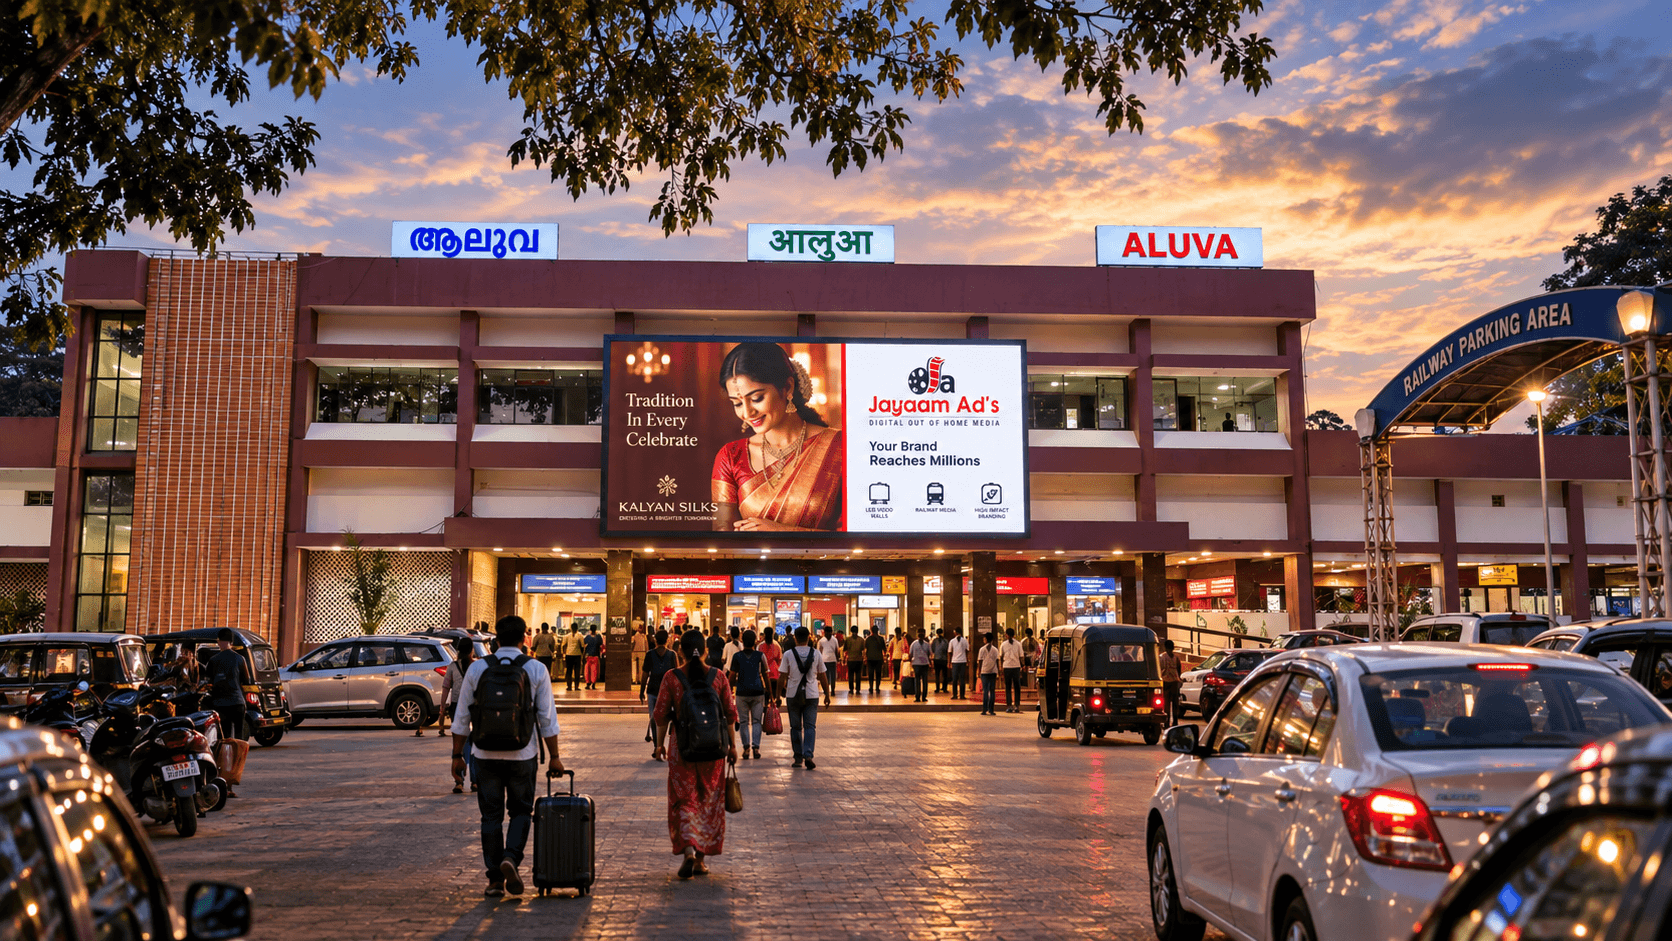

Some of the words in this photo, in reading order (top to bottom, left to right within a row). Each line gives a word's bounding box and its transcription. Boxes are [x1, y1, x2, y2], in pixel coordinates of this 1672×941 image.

[410, 227, 539, 259] ആലുവ
[769, 230, 873, 262] आलुआ
[1122, 232, 1239, 259] ALUVA
[1403, 343, 1454, 396] RAILWAY
[1459, 312, 1521, 357] PARKING
[1526, 302, 1572, 331] AREA
[625, 393, 694, 407] Tradition
[869, 396, 949, 417] Jayaam
[956, 396, 999, 413] Ad's
[627, 413, 642, 427] In
[647, 413, 688, 430] Every
[626, 432, 698, 447] Celebrate
[869, 441, 898, 451] Your
[901, 441, 937, 451] Brand
[870, 455, 926, 466] Reaches
[930, 455, 980, 466] Millions
[619, 502, 675, 512] KALYAN
[679, 502, 719, 512] SILKS
